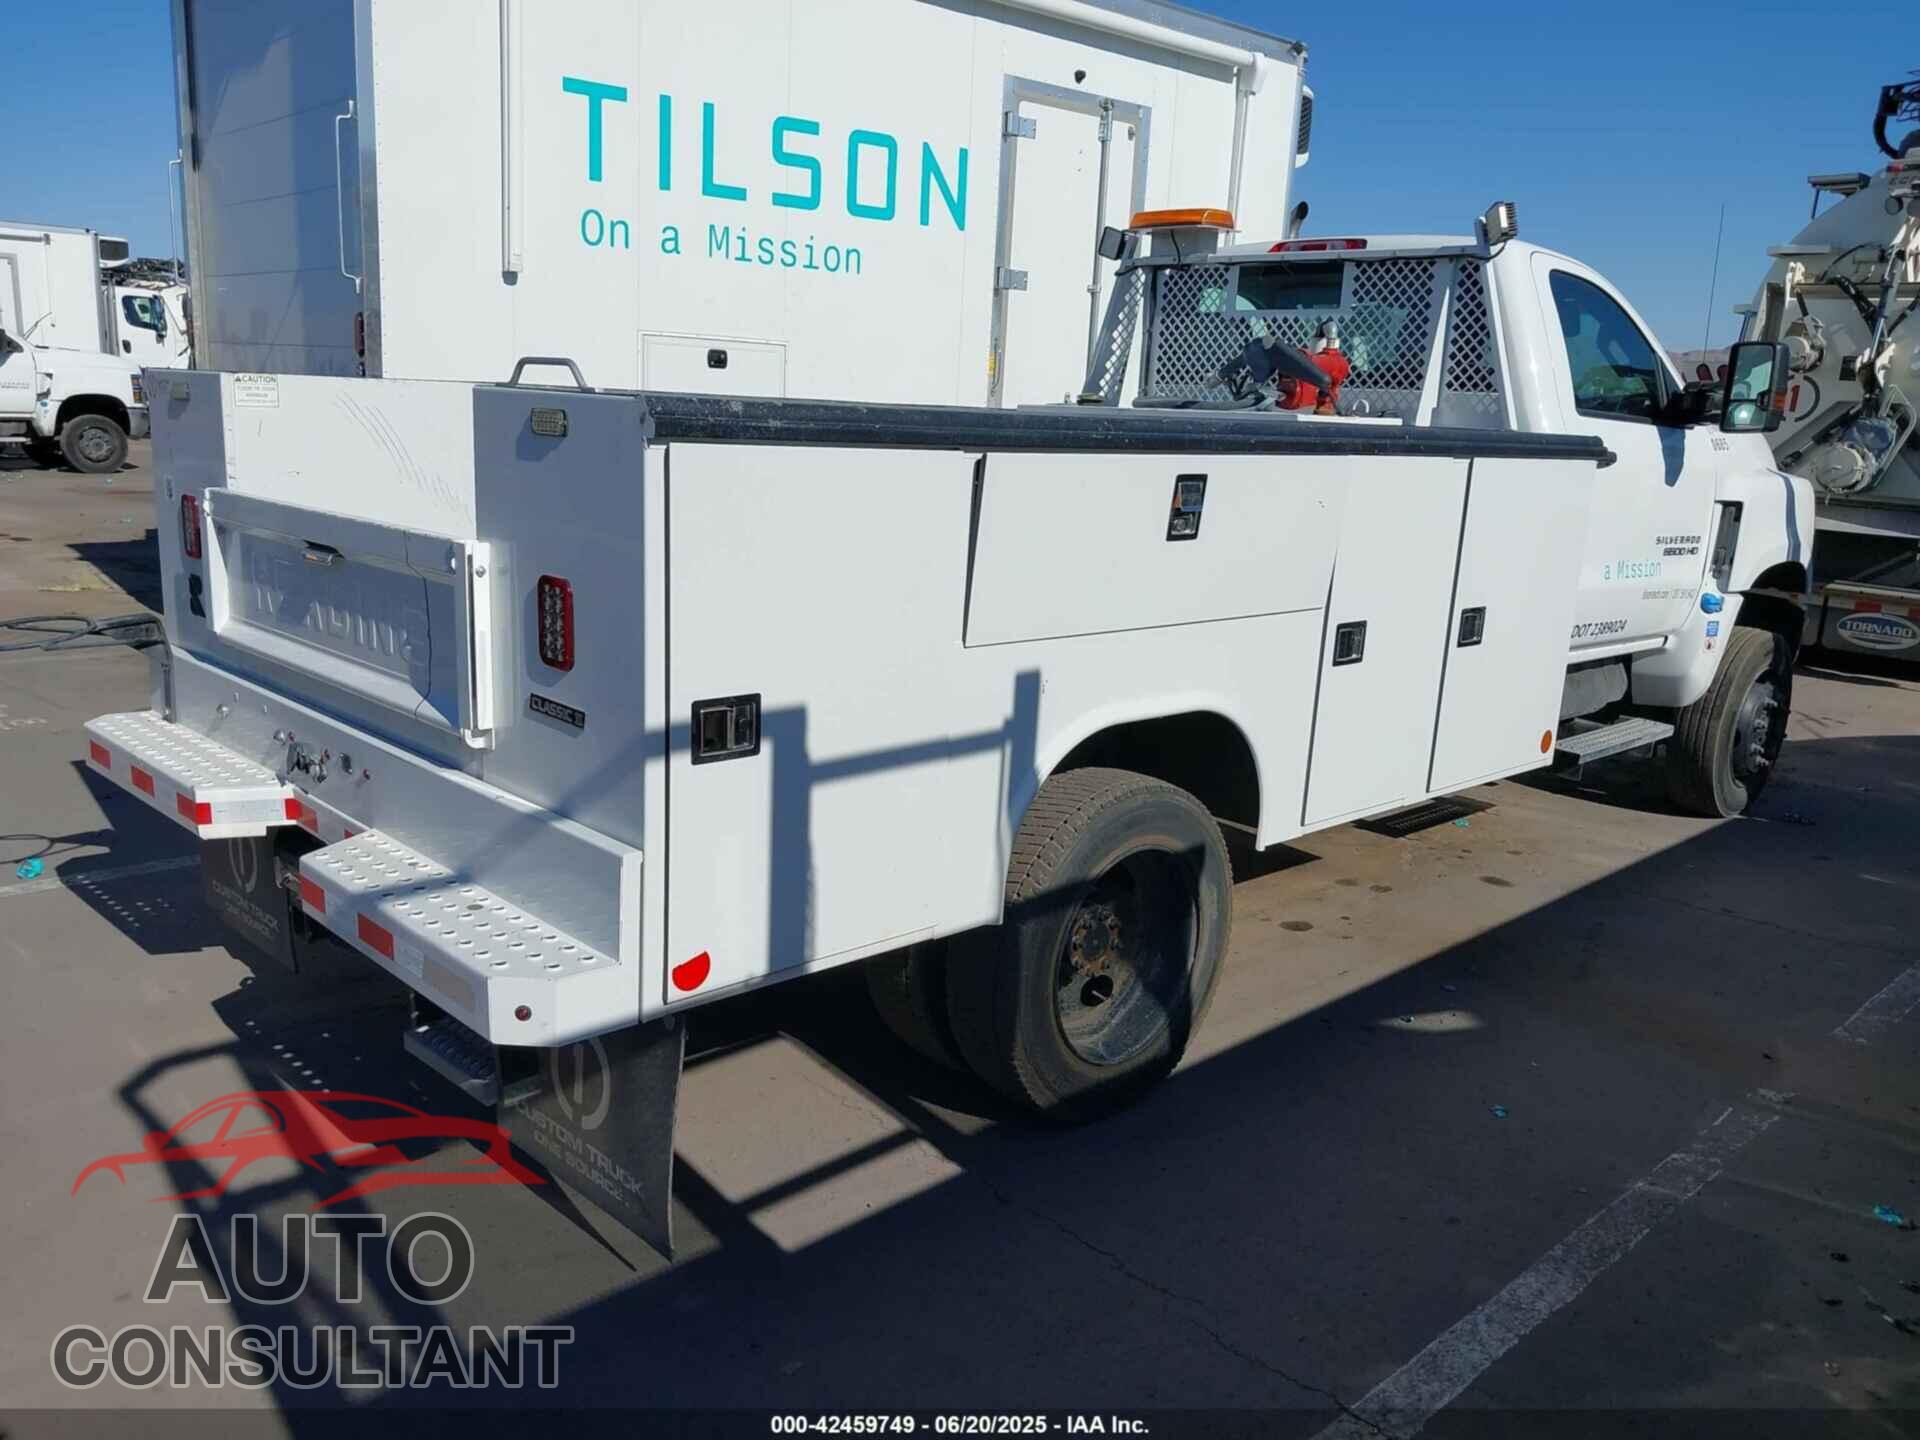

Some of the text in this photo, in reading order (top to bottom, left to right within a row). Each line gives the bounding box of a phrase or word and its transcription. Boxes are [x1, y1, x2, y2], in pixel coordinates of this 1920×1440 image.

[562, 76, 969, 231] TILSON
[580, 208, 861, 275] On a Mission
[242, 375, 277, 384] CAUTION
[1655, 535, 1701, 545] SILVERADO
[1603, 559, 1662, 580] a Mission
[1570, 623, 1592, 639] DOT
[1846, 620, 1913, 638] TORNADO
[531, 697, 572, 722] CLASSIC
[515, 1101, 644, 1196] CUSTOM TRUCK
[533, 1129, 561, 1159] ONE
